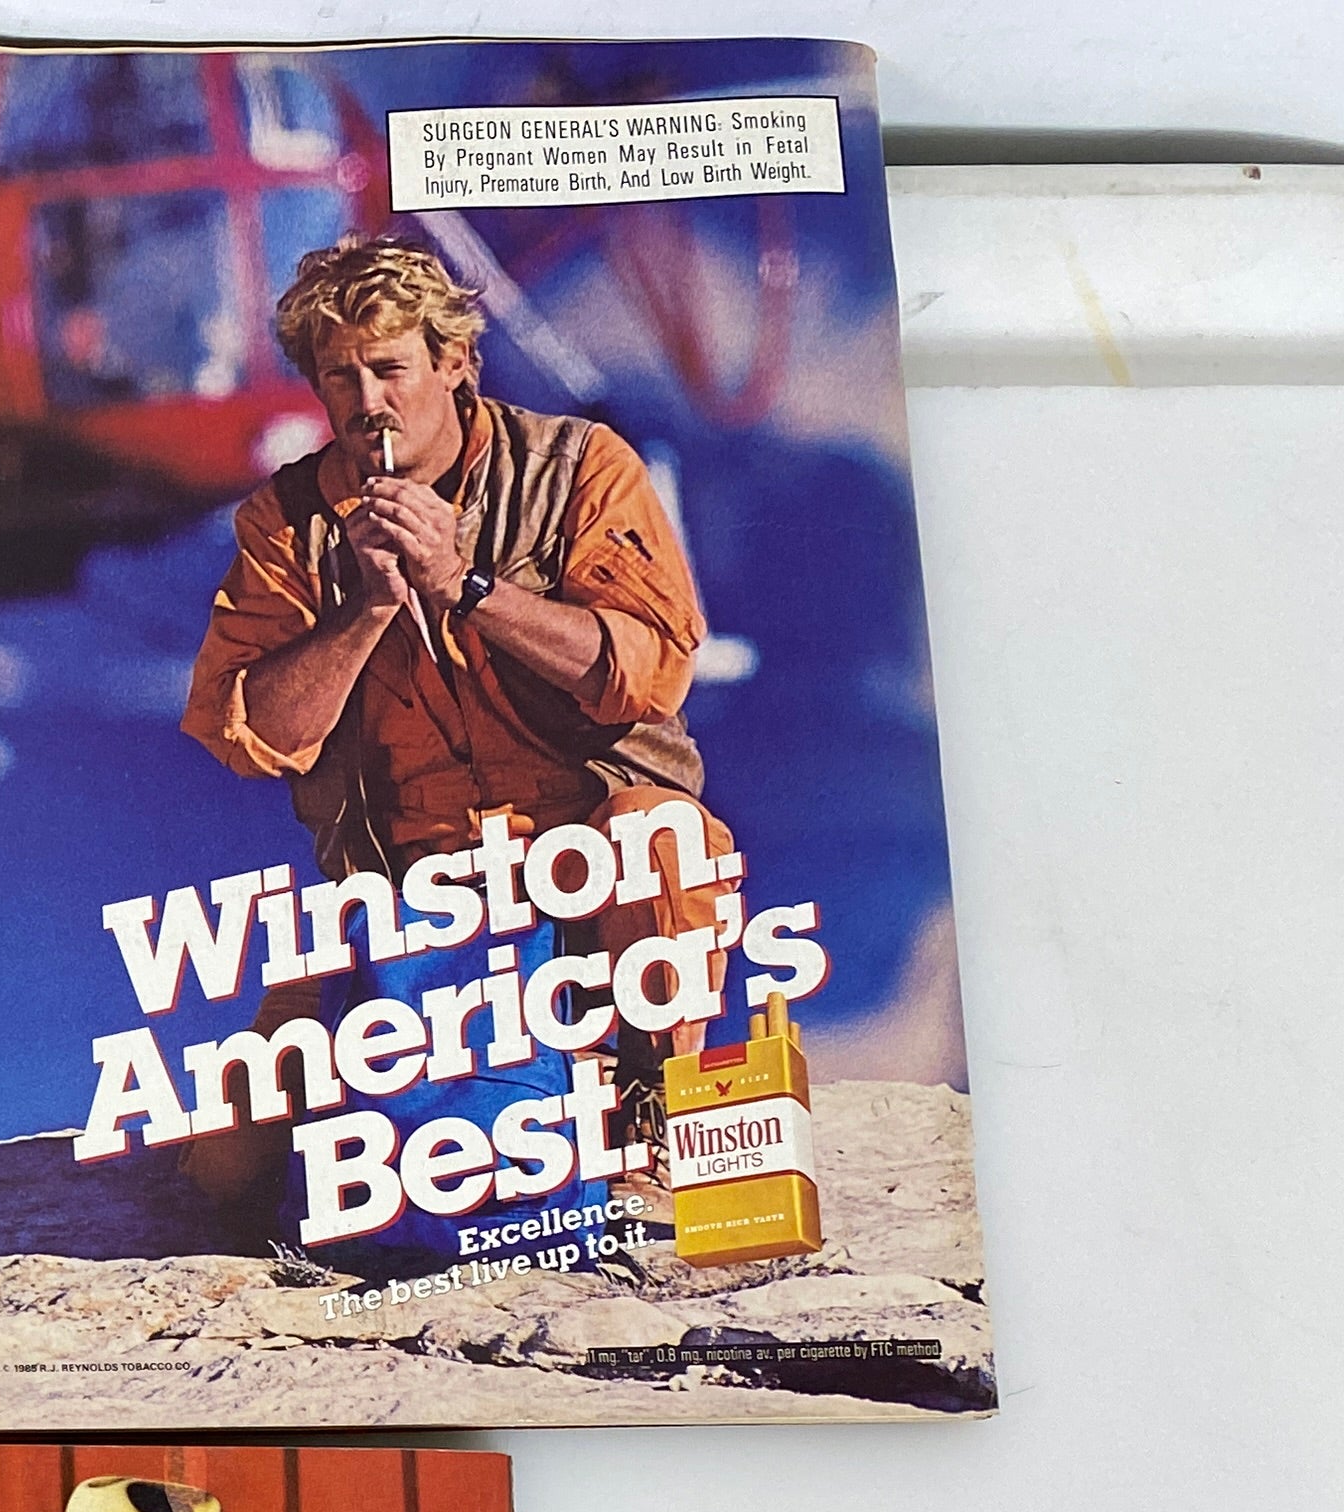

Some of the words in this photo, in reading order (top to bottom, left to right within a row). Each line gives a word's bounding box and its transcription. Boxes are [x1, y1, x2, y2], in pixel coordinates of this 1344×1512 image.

[424, 121, 510, 142] SURGEON
[522, 119, 619, 139] GENERAL'S
[627, 114, 721, 136] WARNING:
[732, 111, 805, 132] Smoking
[425, 150, 445, 171] By
[457, 149, 533, 170] Pregnant
[543, 147, 606, 165] Women
[620, 145, 655, 164] May
[668, 140, 724, 159] Result
[737, 142, 751, 155] in
[767, 136, 808, 154] Fetal
[426, 177, 472, 198] Injury,
[481, 175, 559, 192] Premature
[569, 172, 611, 190] Birth,
[621, 169, 650, 188] And
[661, 169, 693, 186] Low
[704, 164, 741, 183] Birth
[751, 161, 810, 183] Weight.
[102, 799, 747, 1016] Winston.
[72, 892, 829, 1163] America's
[292, 1059, 653, 1246] Best.
[673, 1118, 783, 1160] Winston
[697, 1153, 763, 1176] LIGHTS
[458, 1194, 655, 1256] Excellence.
[319, 1290, 382, 1321] The
[388, 1266, 463, 1305] best
[469, 1251, 531, 1287] live
[537, 1241, 579, 1273] up
[585, 1234, 618, 1260] to
[624, 1221, 656, 1251] it.
